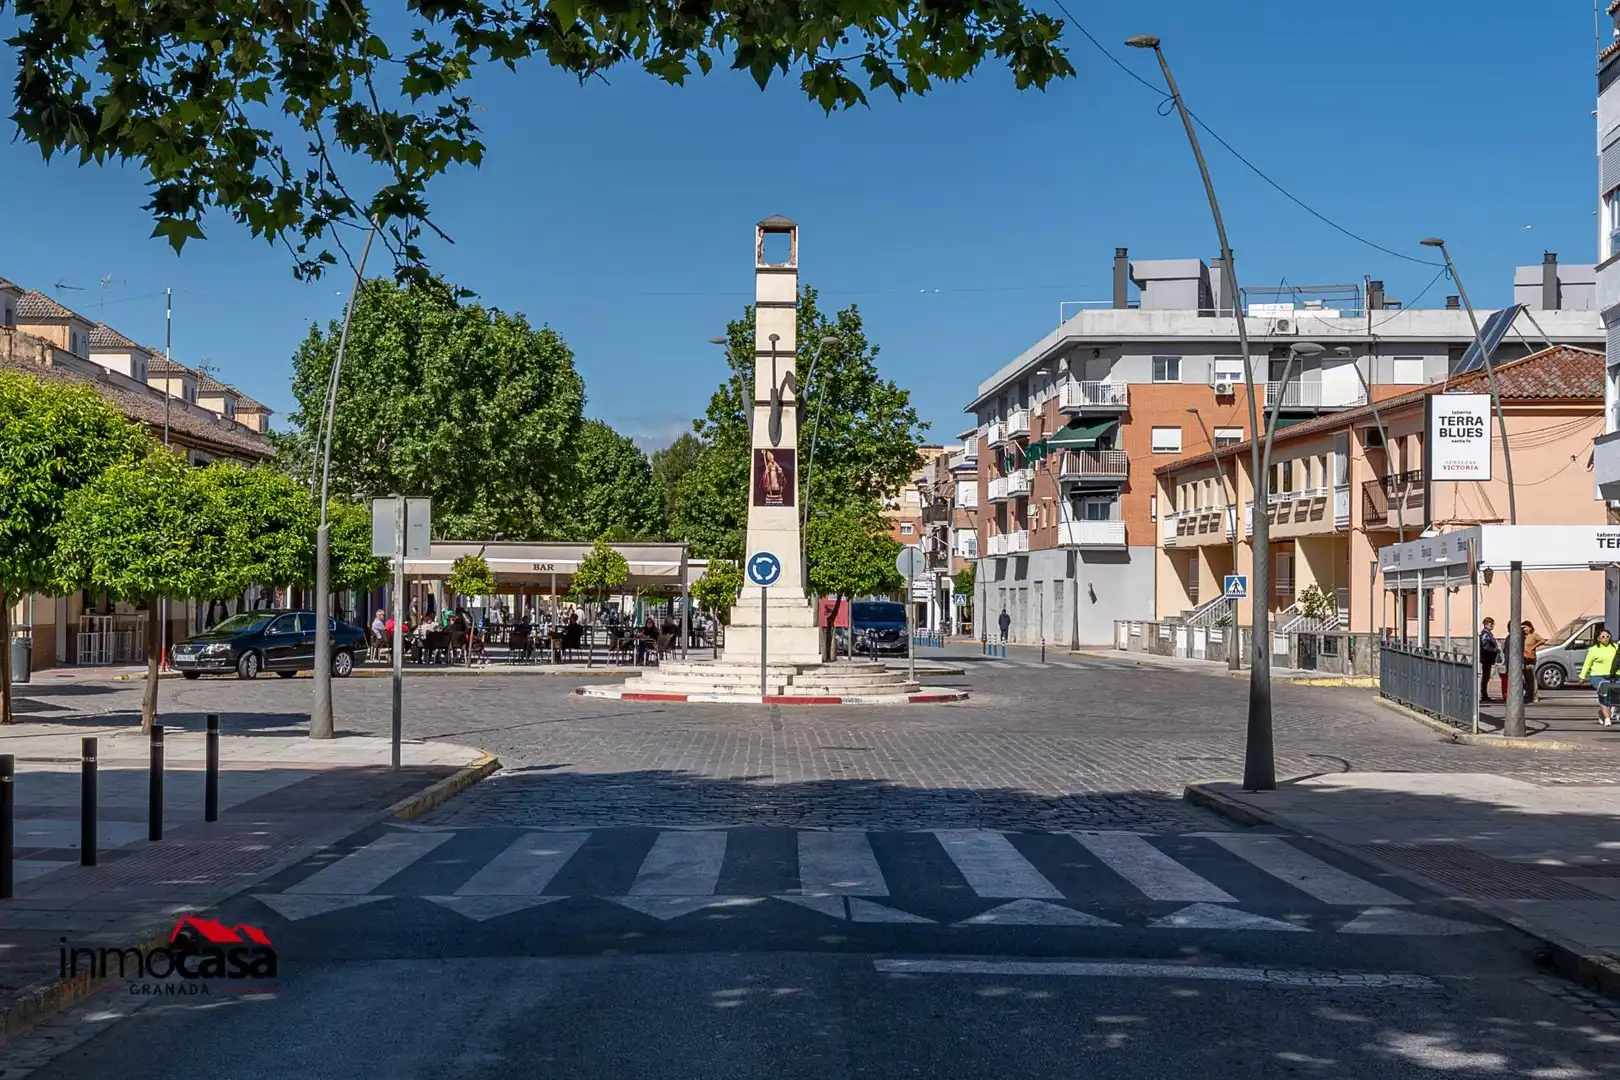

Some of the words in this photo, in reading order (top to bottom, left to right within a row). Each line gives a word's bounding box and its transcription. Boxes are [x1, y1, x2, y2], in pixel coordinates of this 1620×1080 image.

[1438, 415, 1484, 426] TERRA
[1439, 427, 1483, 438] BLUES
[533, 563, 555, 571] BAR
